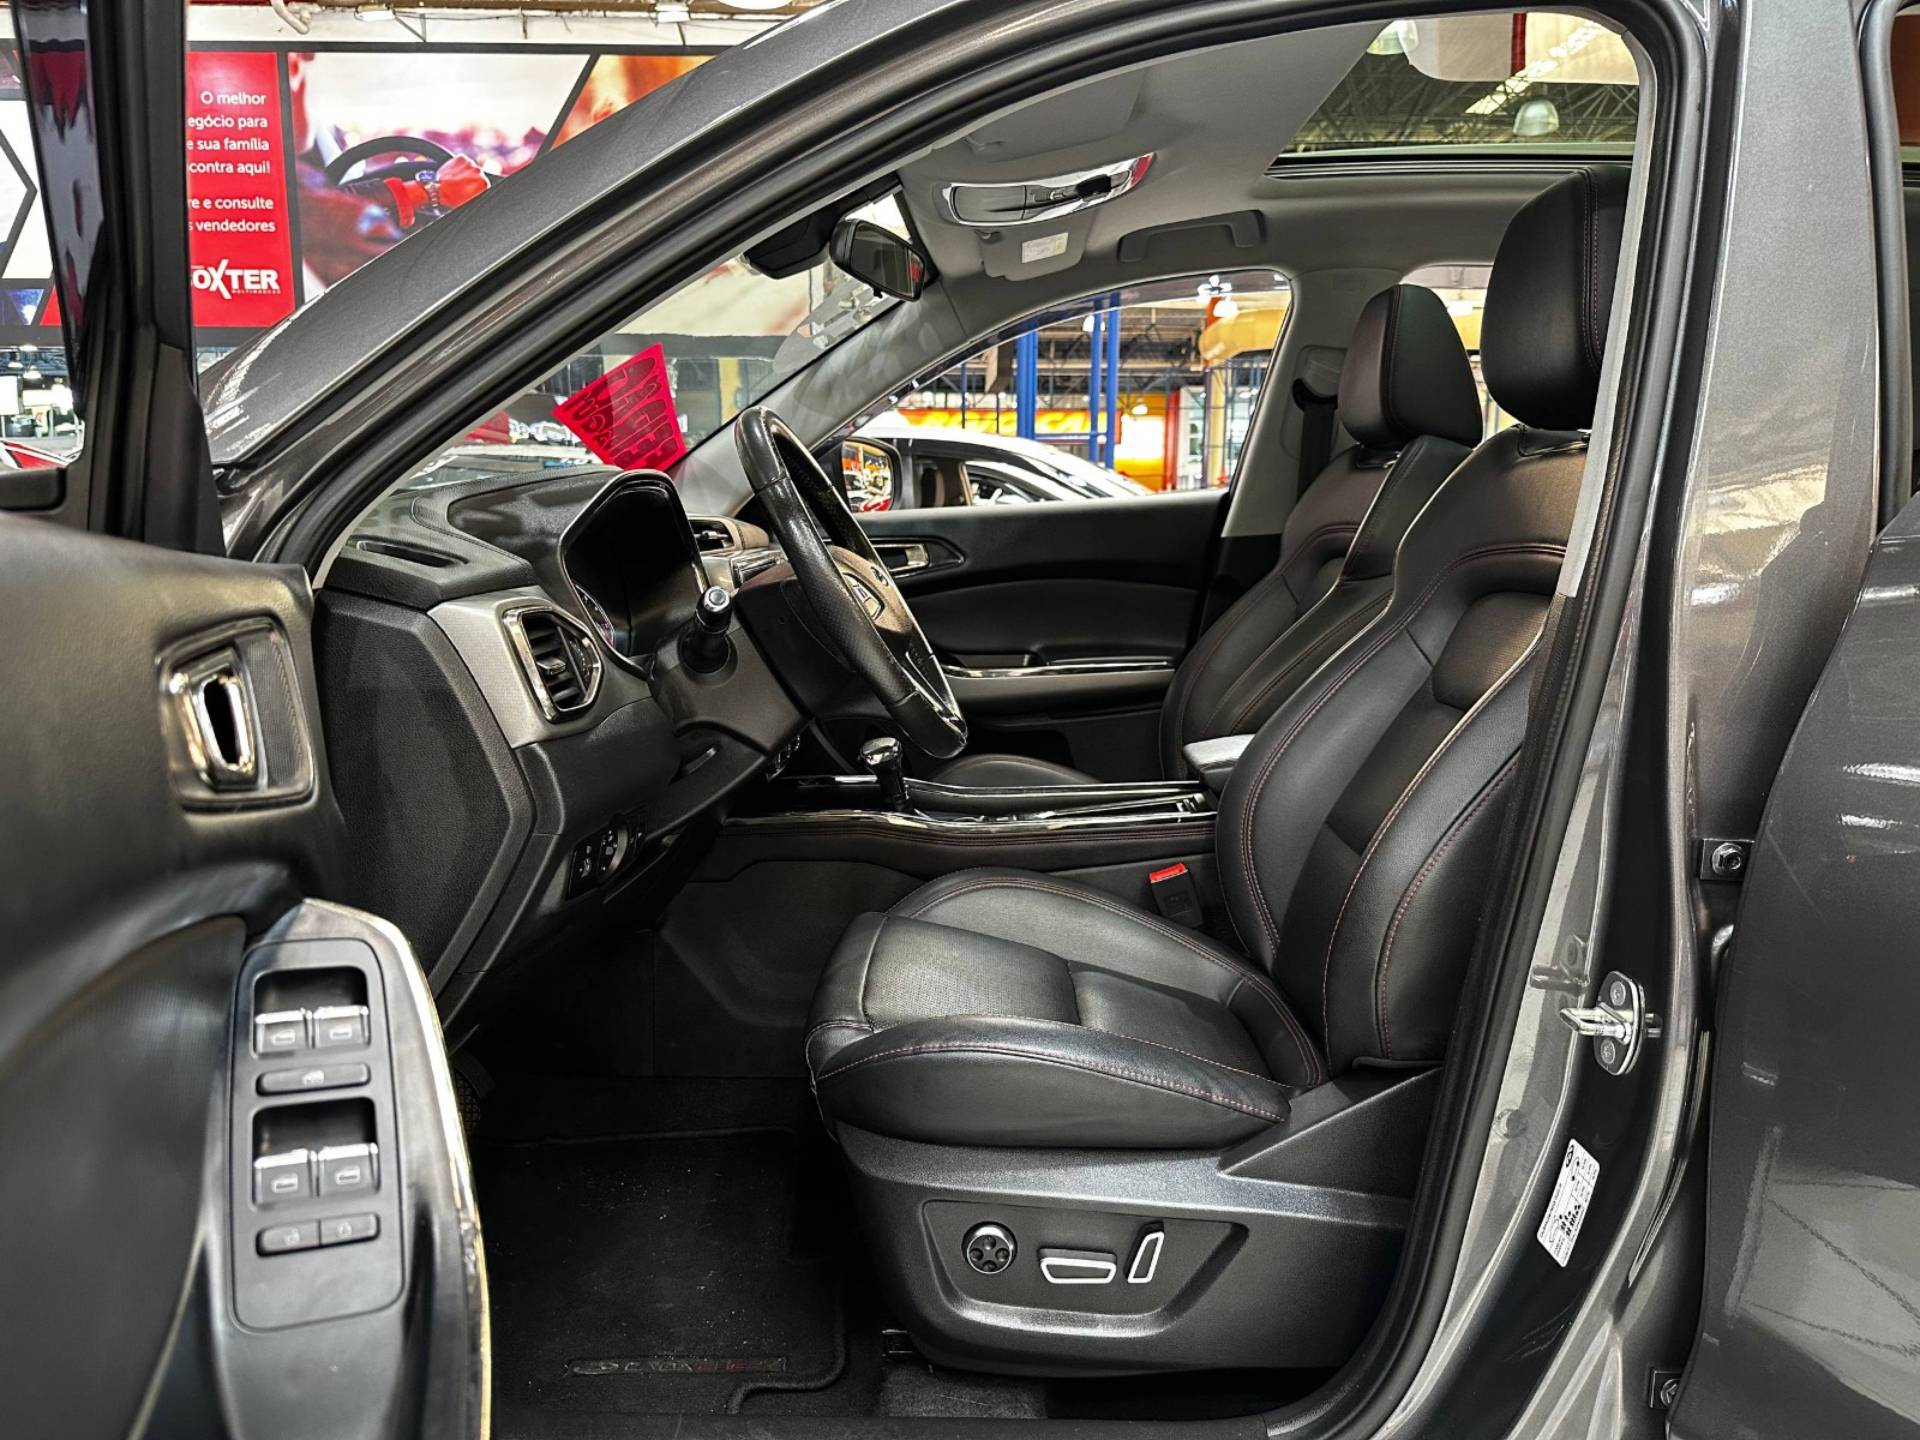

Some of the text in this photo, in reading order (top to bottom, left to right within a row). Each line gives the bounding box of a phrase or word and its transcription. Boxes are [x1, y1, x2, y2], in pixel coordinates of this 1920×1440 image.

[200, 90, 267, 105] O melhor
[187, 114, 268, 130] egócio para
[197, 139, 221, 151] sua
[223, 137, 270, 151] família
[188, 160, 271, 176] contra aqui!
[202, 198, 212, 209] e
[214, 196, 274, 209] consulte
[195, 218, 277, 232] vendedores
[190, 258, 281, 300] OXTER
